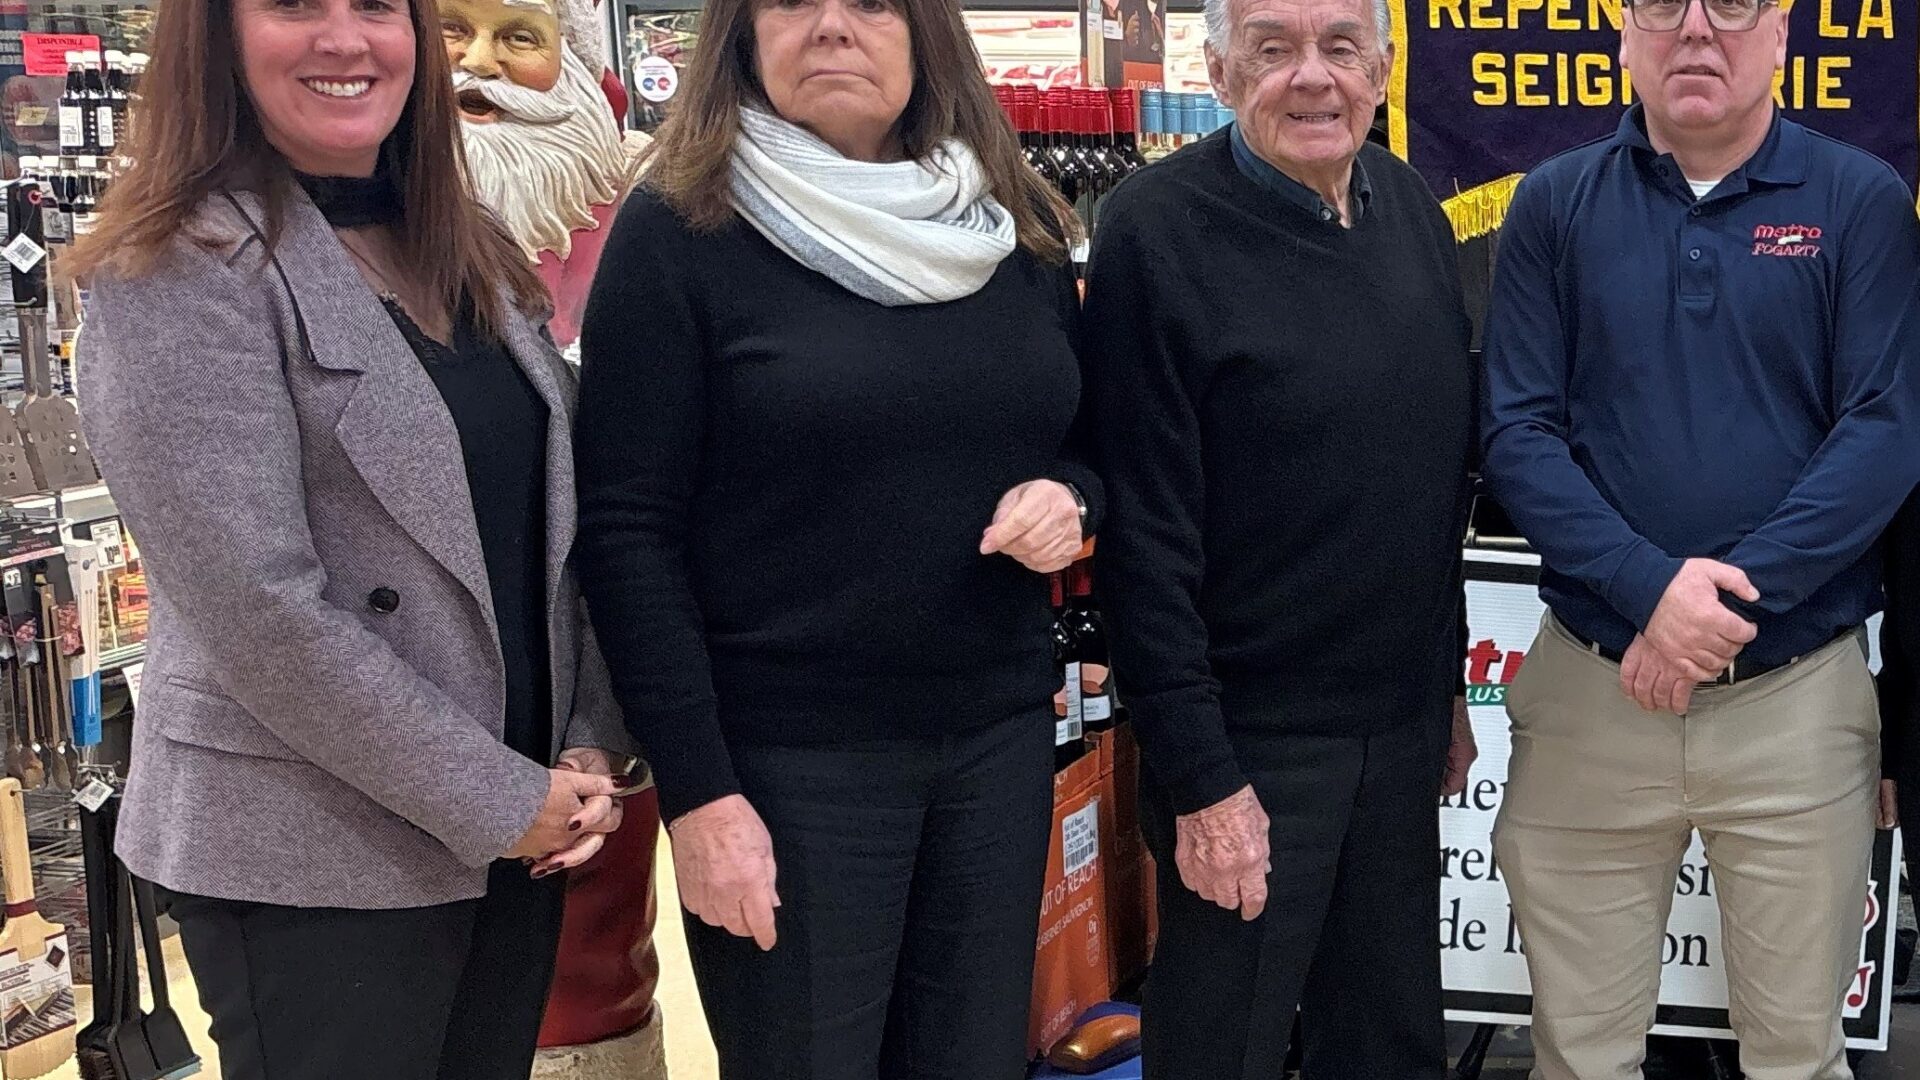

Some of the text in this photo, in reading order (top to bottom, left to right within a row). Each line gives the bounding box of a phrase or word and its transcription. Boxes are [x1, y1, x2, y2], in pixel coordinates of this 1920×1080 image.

[1819, 0, 1894, 38] LA
[1753, 224, 1822, 239] metro
[1751, 242, 1821, 259] FOGARTY
[1466, 687, 1505, 702] LUS
[1054, 880, 1066, 905] OF
[1067, 860, 1097, 895] REACH
